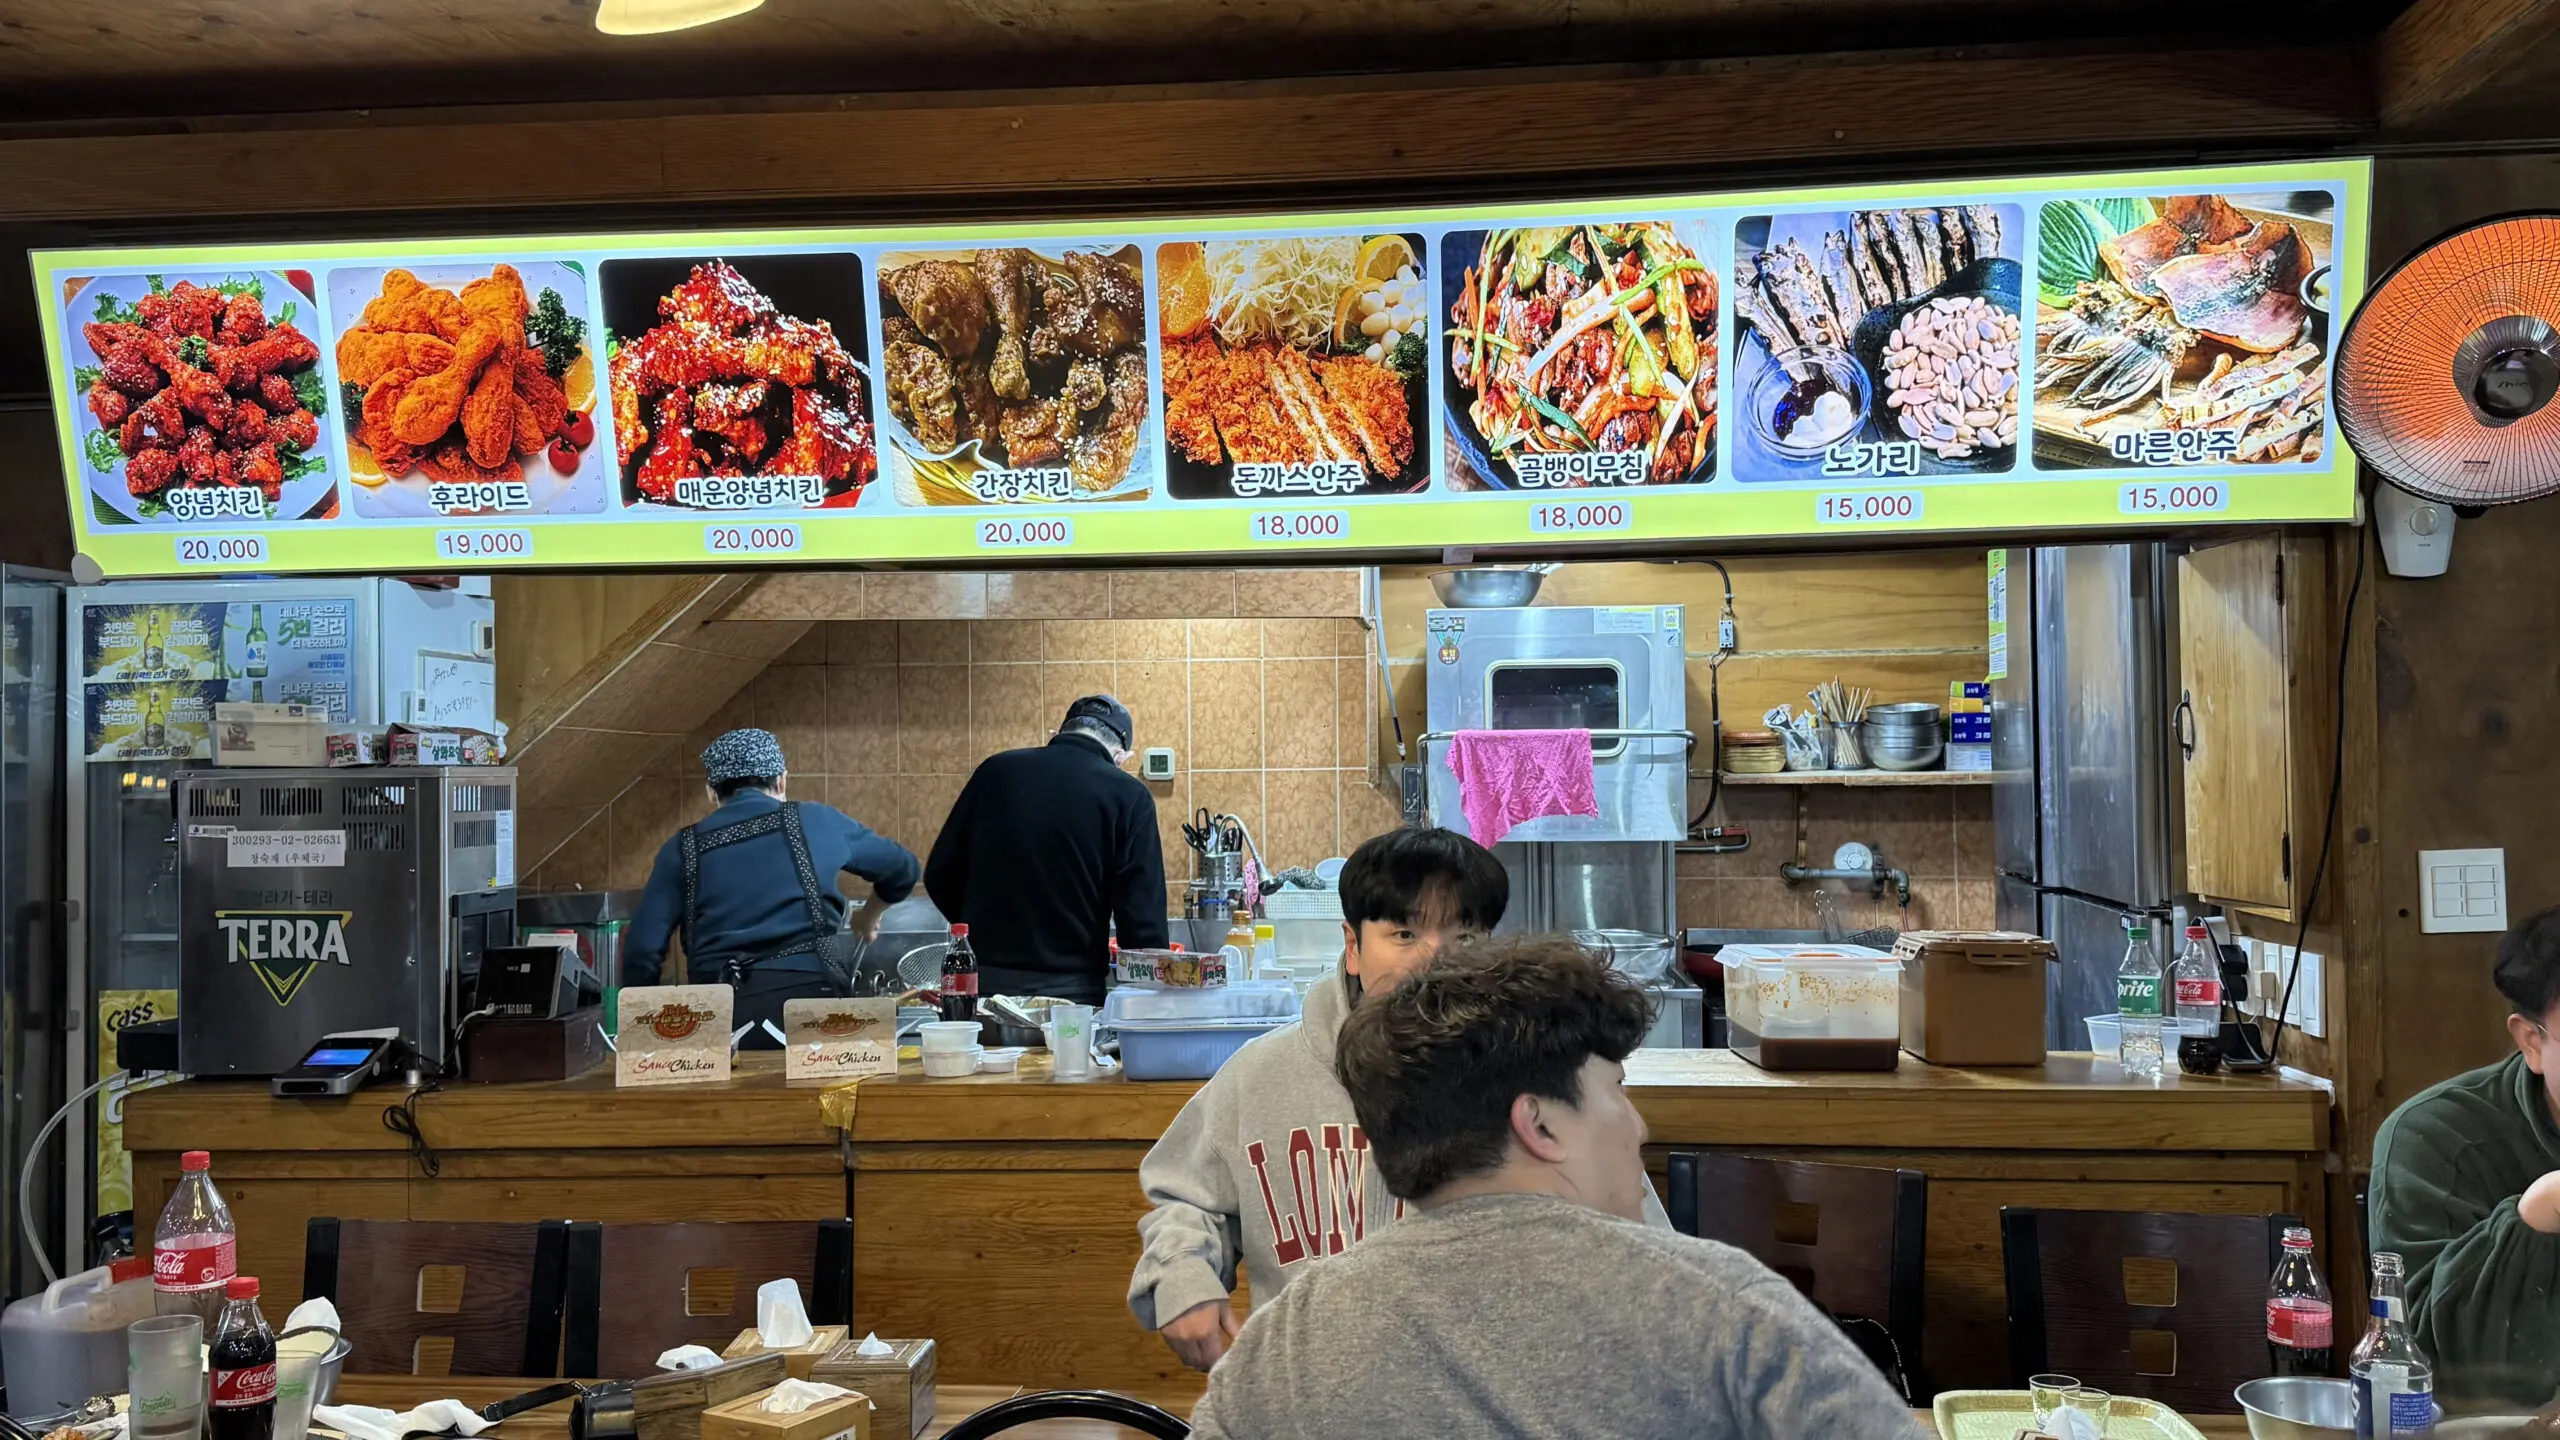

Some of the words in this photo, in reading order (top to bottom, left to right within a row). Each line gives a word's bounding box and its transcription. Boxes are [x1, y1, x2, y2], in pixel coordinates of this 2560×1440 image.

[1825, 441, 1918, 474] 노가리
[2115, 431, 2237, 464] 마른안주
[1234, 464, 1364, 495] 돈까스안주
[1519, 453, 1644, 486] 골뱅이무침
[431, 482, 530, 512] 후라이드
[678, 478, 823, 506] 매운양념치킨
[976, 470, 1071, 499] 간장치킨
[170, 488, 262, 517] 양념치킨
[1823, 495, 1913, 520] 15,000
[2127, 485, 2219, 511] 15,000
[1256, 515, 1340, 537] 18,000
[1537, 505, 1623, 529] 18,000
[443, 532, 524, 557] 19,000
[711, 526, 795, 551] 20,000
[983, 520, 1066, 546] 20,000
[182, 539, 260, 562] 20,000
[313, 618, 346, 637] 걸러
[231, 834, 342, 847] 300293-02-026631
[218, 918, 351, 966] TERRA
[2117, 979, 2154, 998] prite
